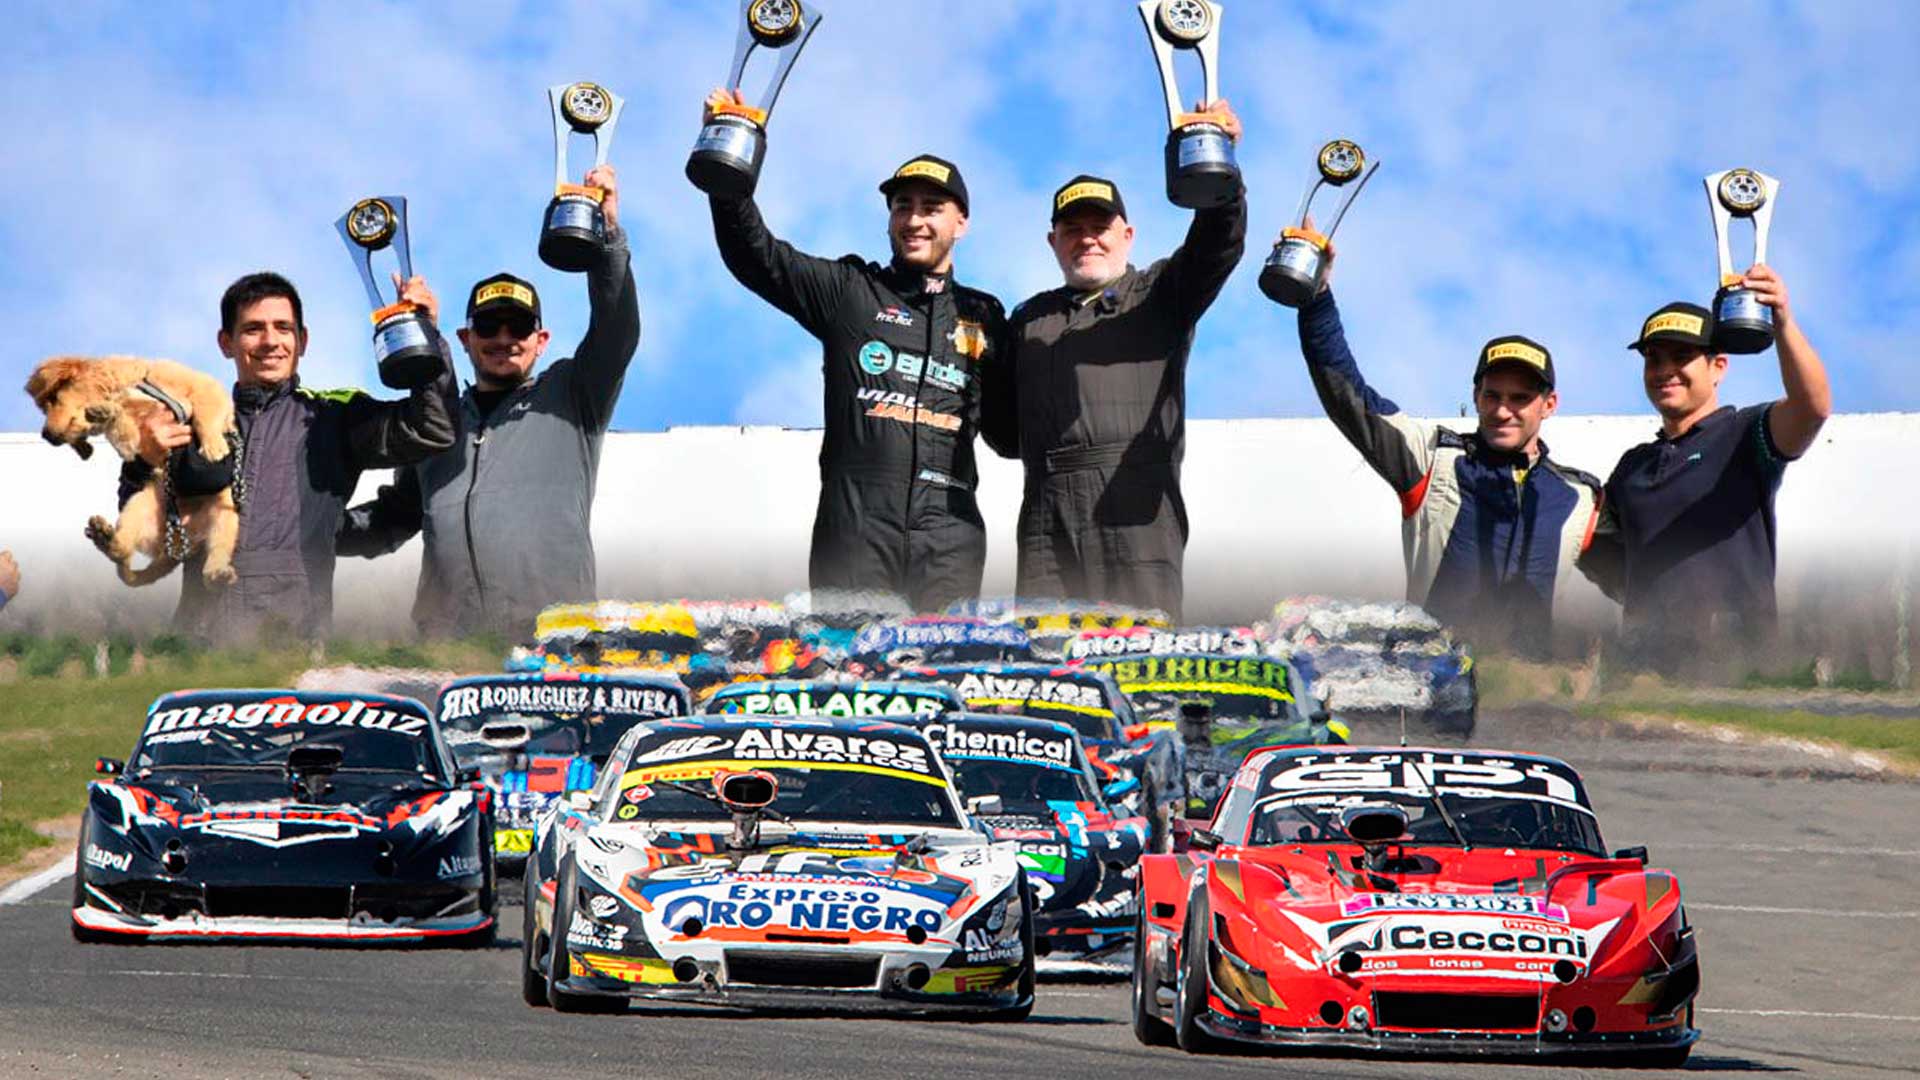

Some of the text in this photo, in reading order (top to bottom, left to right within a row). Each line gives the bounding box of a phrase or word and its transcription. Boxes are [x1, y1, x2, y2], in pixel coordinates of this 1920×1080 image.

[481, 686, 590, 708] RODRIGUEZ
[612, 687, 679, 717] RIVERA
[745, 692, 944, 719] PALAKAR
[143, 699, 429, 737] magnoluz
[734, 728, 926, 760] Alvarez
[922, 723, 1072, 761] Chemical
[733, 747, 930, 773] NEUMATICOS
[728, 884, 881, 905] Expreso
[789, 903, 943, 933] NEGRO
[1390, 925, 1587, 958] Cecconi
[1429, 958, 1484, 969] lonas
